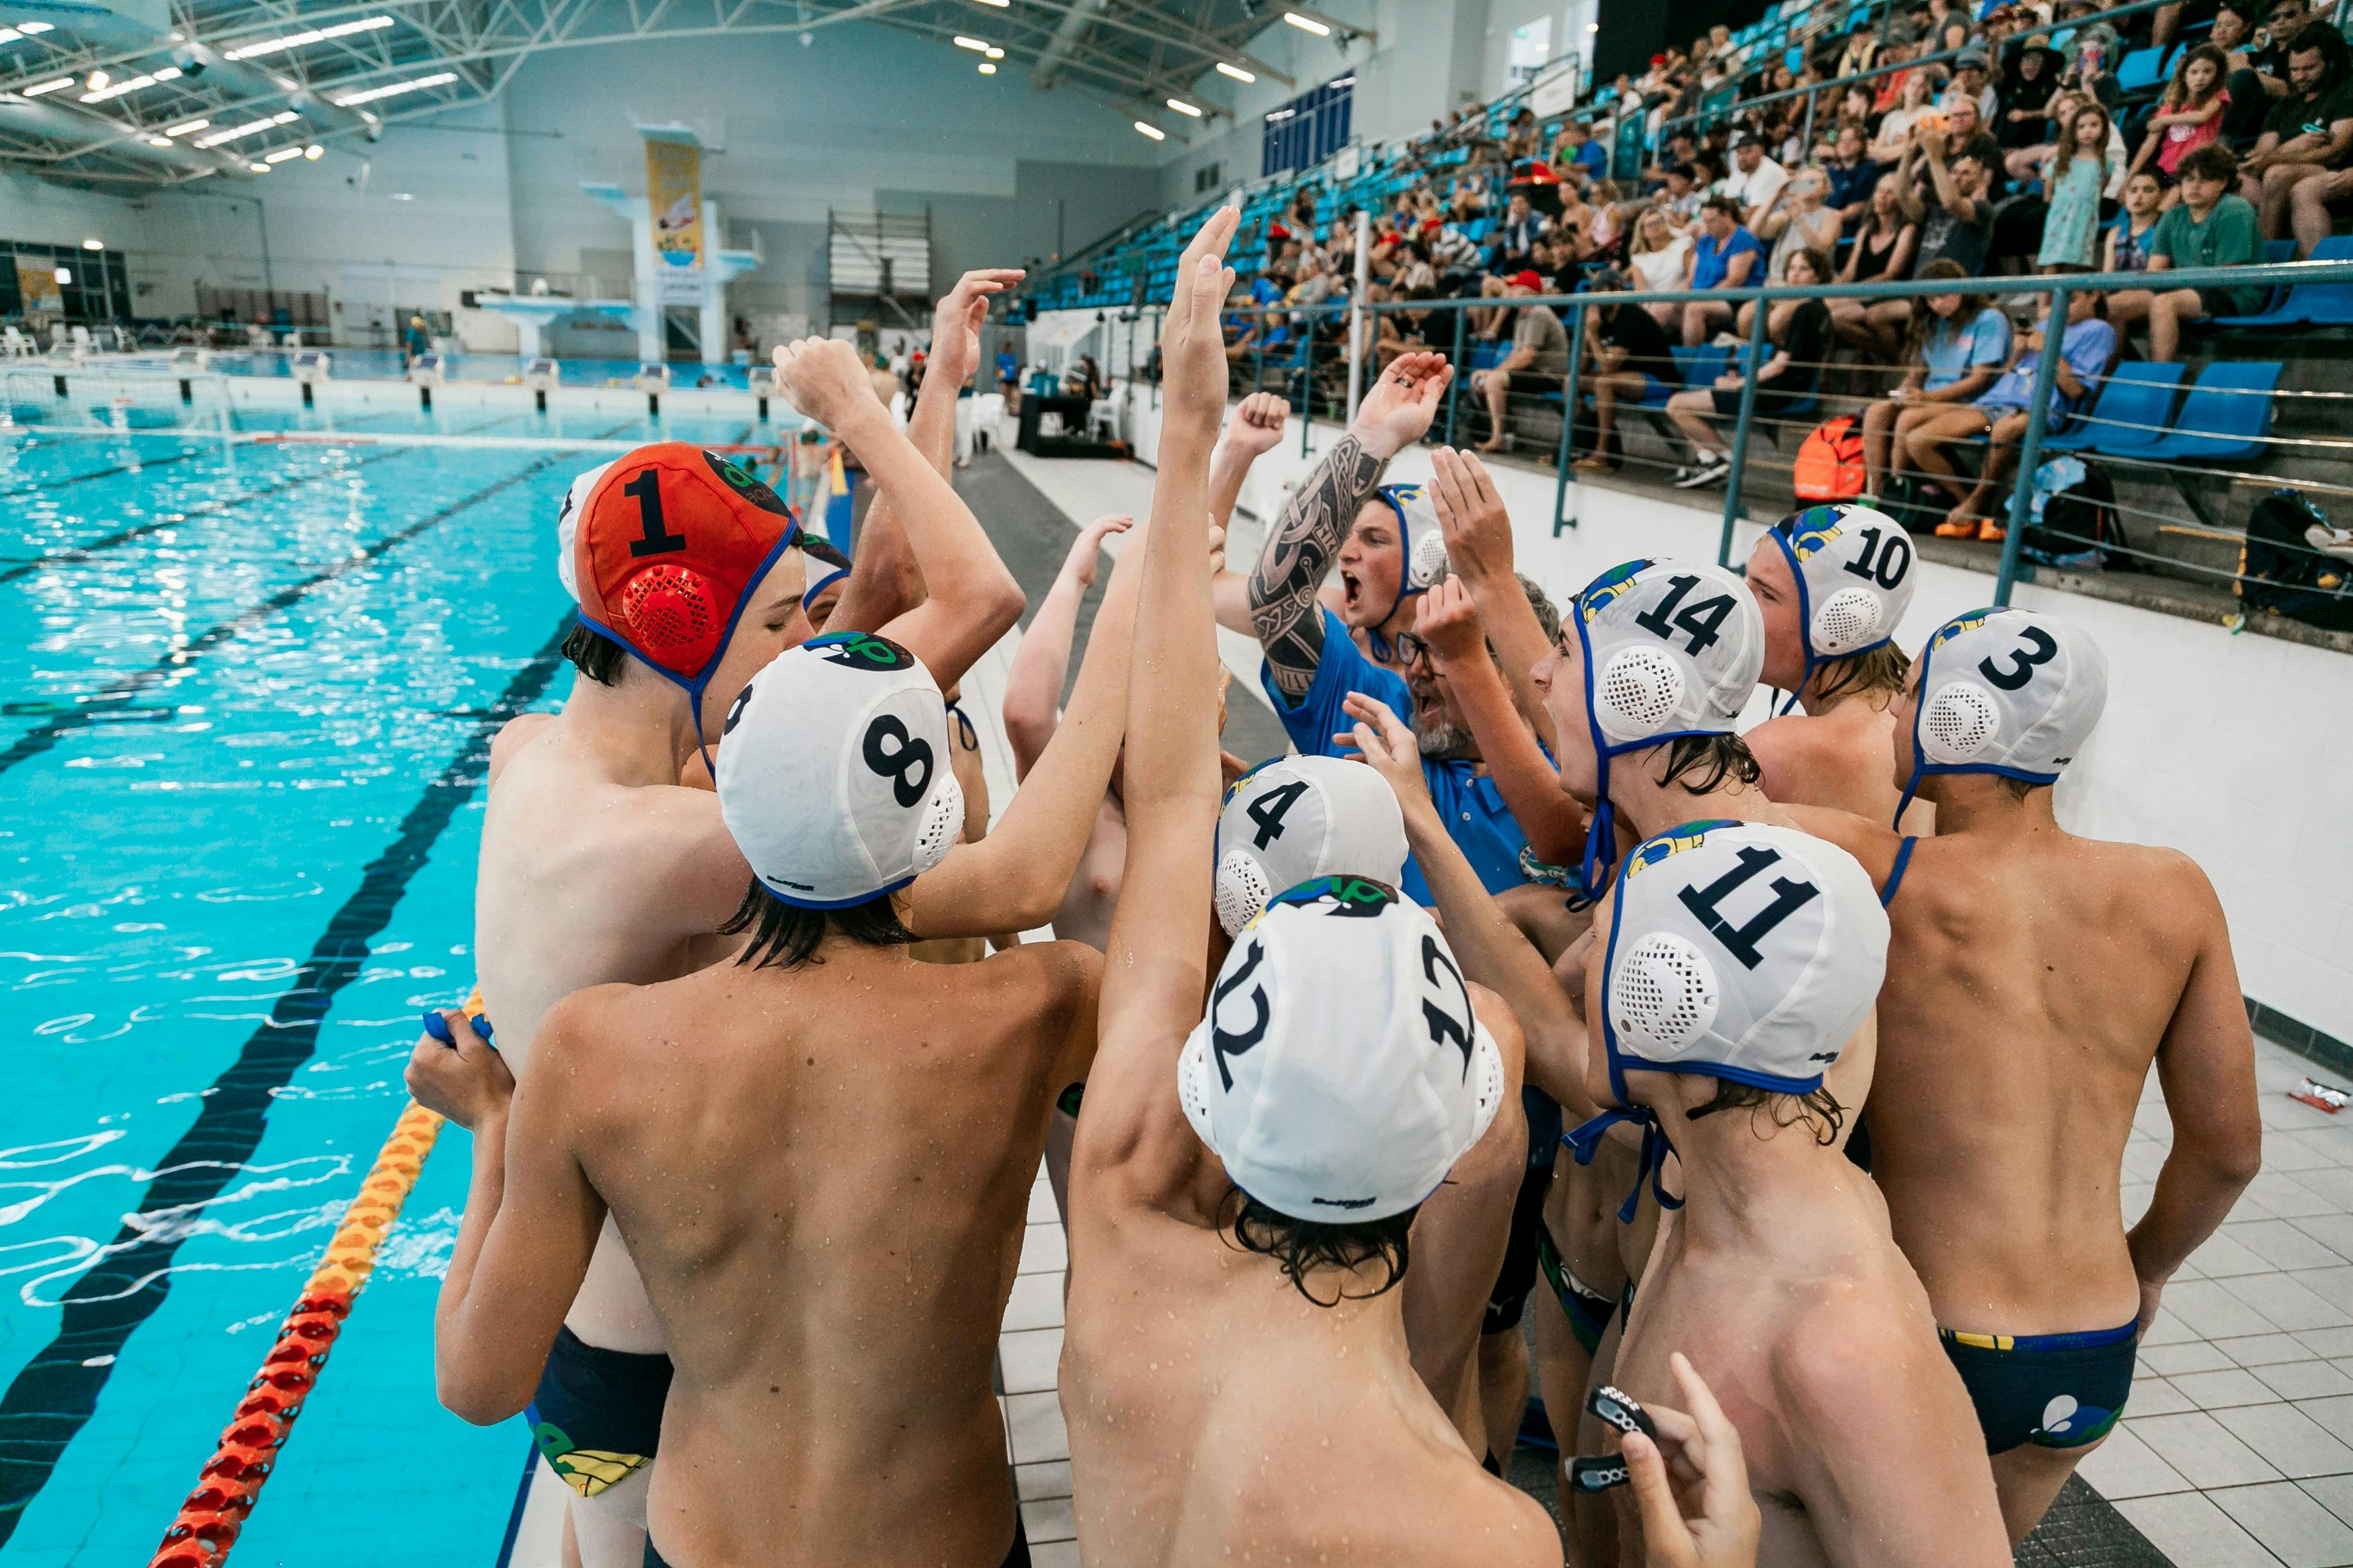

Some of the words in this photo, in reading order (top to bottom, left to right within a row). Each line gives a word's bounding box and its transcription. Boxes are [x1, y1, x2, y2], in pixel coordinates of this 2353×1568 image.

[624, 468, 686, 558] 1
[1843, 527, 1911, 591] 10
[1635, 575, 1738, 657] 14
[1978, 626, 2057, 691] 3
[863, 714, 934, 809] 8
[1246, 780, 1310, 852] 4
[1677, 845, 1821, 971] 11
[1212, 937, 1270, 1094] 12
